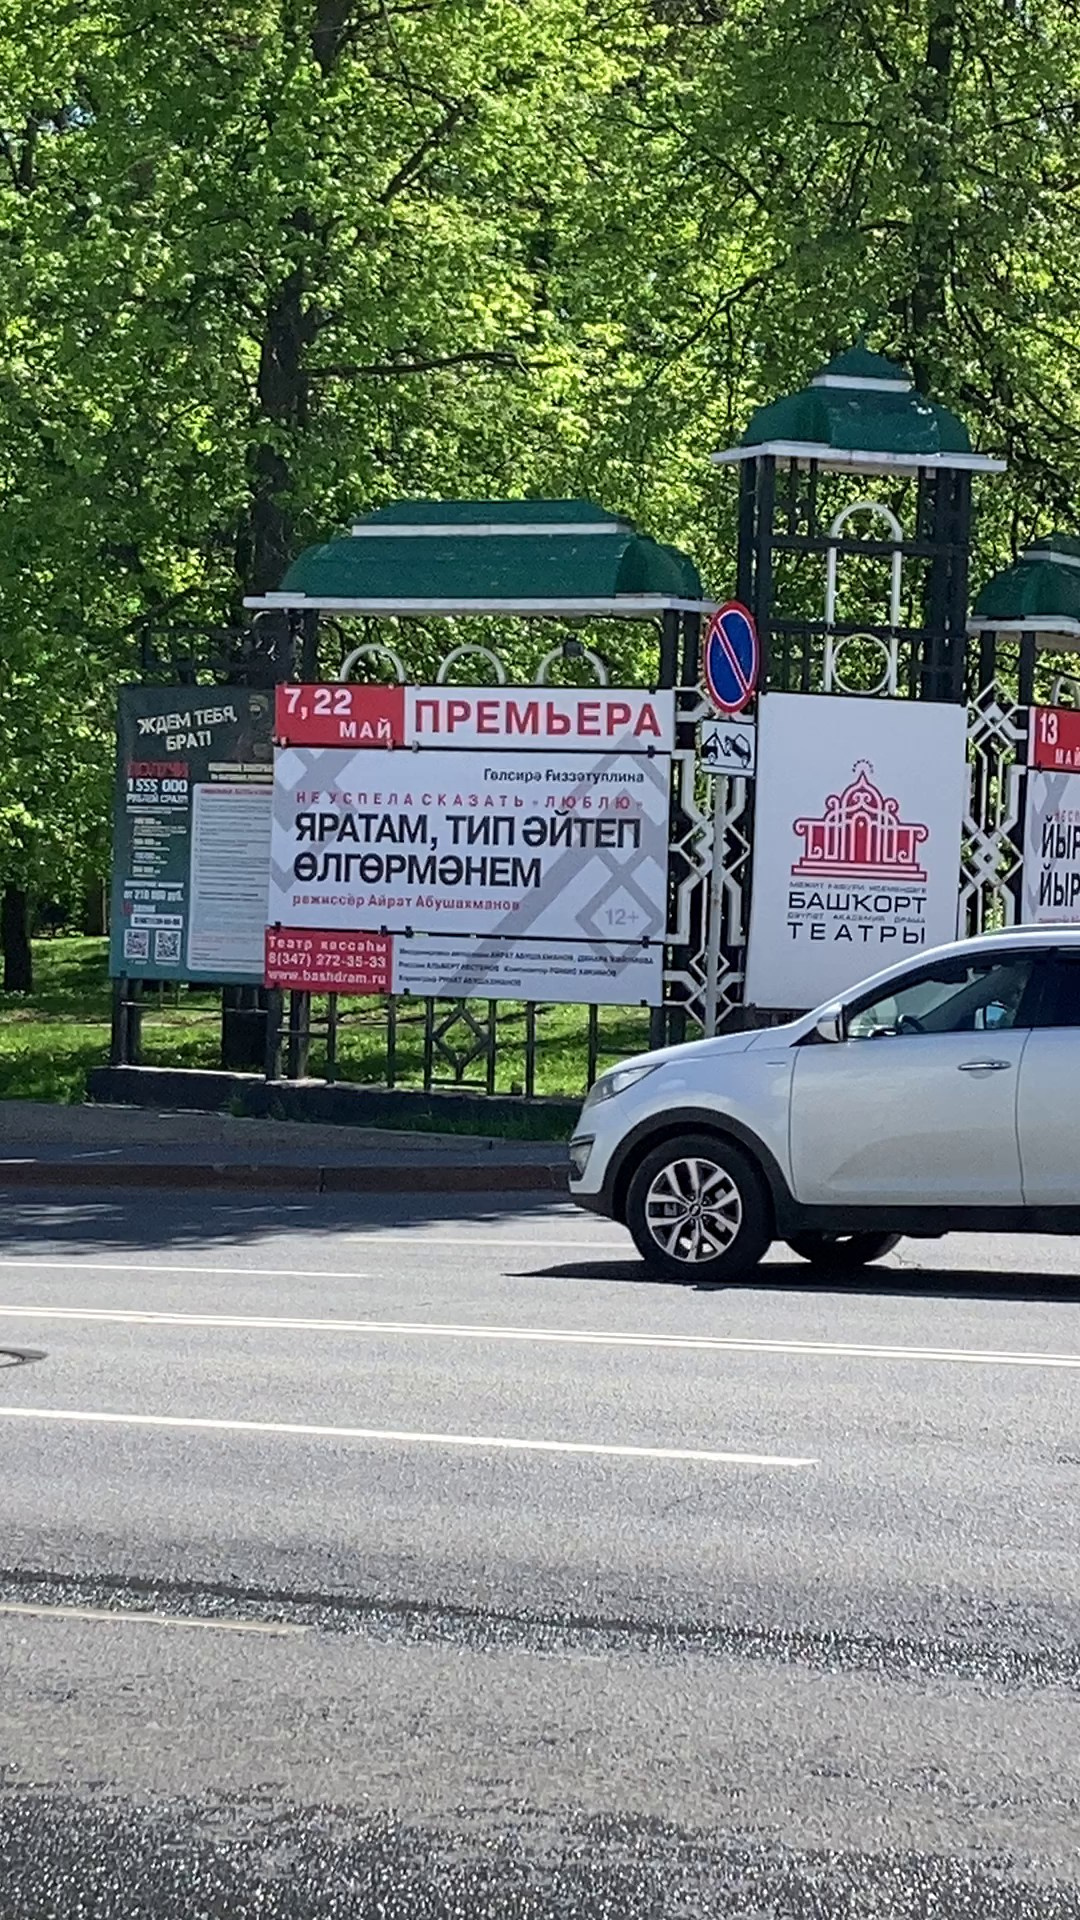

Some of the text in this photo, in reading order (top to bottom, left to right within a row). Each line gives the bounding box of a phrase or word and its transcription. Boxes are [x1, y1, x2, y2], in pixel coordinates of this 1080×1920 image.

[137, 712, 191, 735] ЖДЕМ
[415, 699, 662, 737] ПРЕМЬЕРА
[339, 718, 392, 738] МАЙ
[1040, 712, 1058, 745] 13
[162, 779, 188, 793] 000
[296, 791, 320, 804] НЕ
[329, 791, 413, 806] УСПЕЛА
[421, 793, 524, 808] СКАЗАТЬ
[295, 812, 438, 851] ЯРАТАМ,
[446, 815, 515, 846] ТИП
[522, 809, 641, 849] ӘЙТЕП
[293, 852, 541, 888] ӨЛГӨРМӘНЕМ
[368, 893, 413, 909] Айрат
[605, 908, 640, 926] 12+
[787, 922, 925, 945] ТЕАТРЫ
[268, 936, 313, 952] Театр
[268, 952, 312, 968] 8(347)
[316, 954, 386, 969] 272-35-33
[267, 969, 387, 985] www.bashdram.ru
